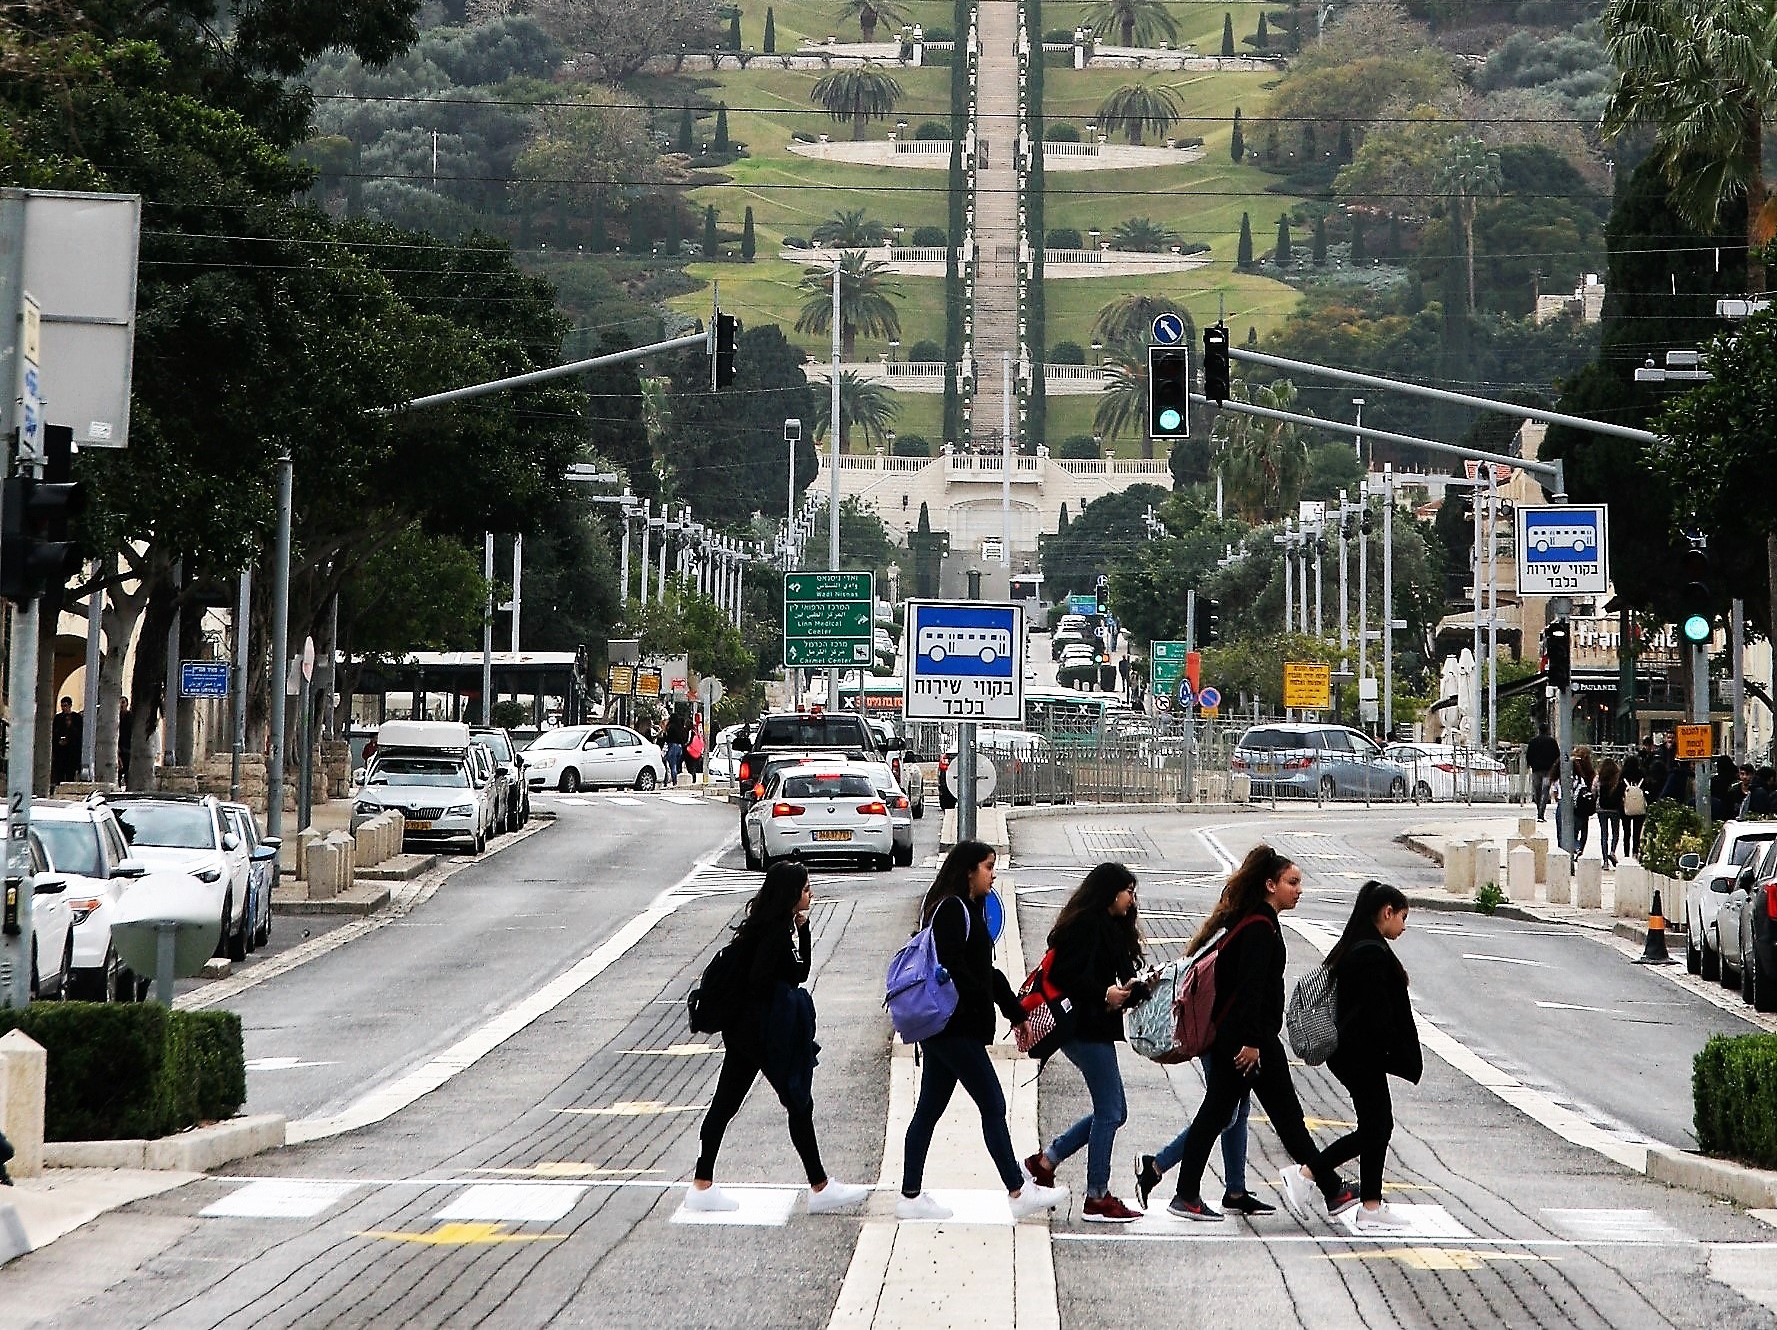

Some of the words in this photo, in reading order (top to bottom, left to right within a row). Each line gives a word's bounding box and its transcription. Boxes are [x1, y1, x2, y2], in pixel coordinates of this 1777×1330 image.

[1526, 564, 1561, 575] שירות
[1568, 565, 1598, 576] בקווי
[1546, 576, 1578, 588] בלבד
[803, 640, 828, 648] הכרמל
[914, 679, 962, 694] שירות
[973, 680, 1014, 697] בקווי
[1580, 683, 1618, 691] PAULANER
[942, 697, 985, 715] בלבד
[11, 791, 24, 813] 2
